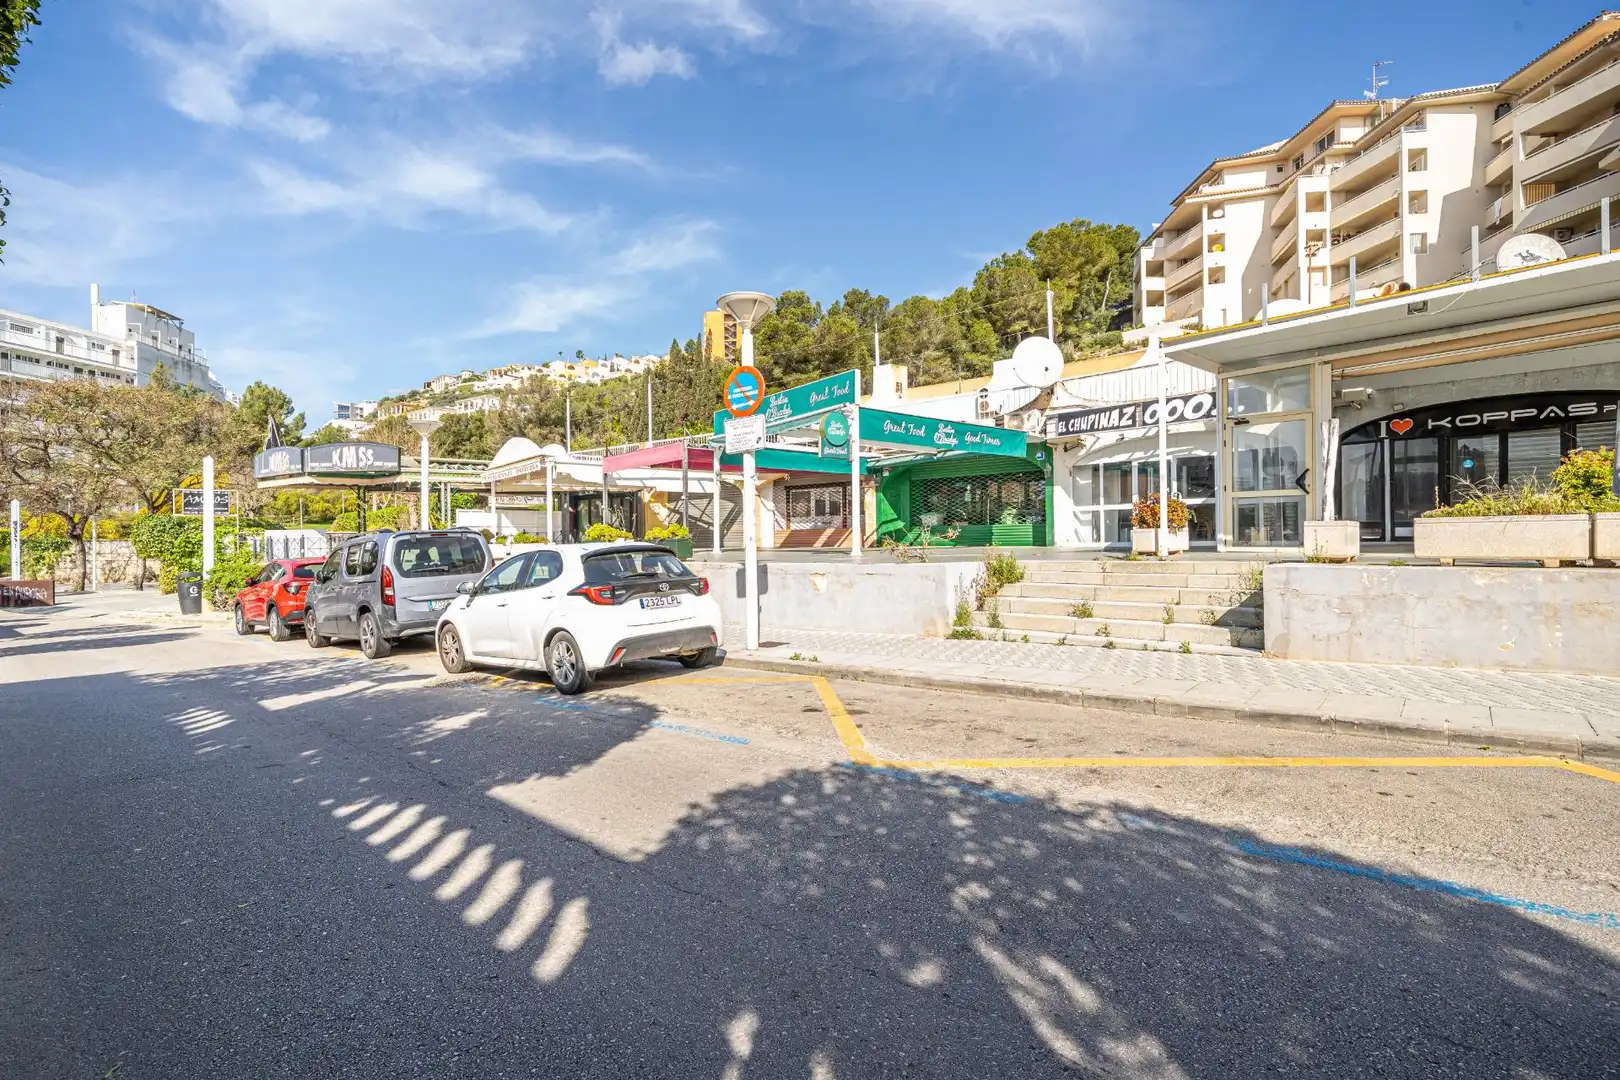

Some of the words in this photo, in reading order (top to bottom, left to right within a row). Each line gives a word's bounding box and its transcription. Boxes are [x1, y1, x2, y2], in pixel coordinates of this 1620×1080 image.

[1058, 421, 1067, 432] EL
[1068, 406, 1136, 431] CHUPINAZ
[1378, 420, 1389, 438] I
[1427, 402, 1598, 430] KOPPAS
[883, 420, 906, 435] Great
[907, 423, 926, 437] Food
[964, 431, 981, 444] Good
[982, 433, 1001, 446] Times
[645, 597, 665, 608] 2325
[666, 595, 682, 605] LPL
